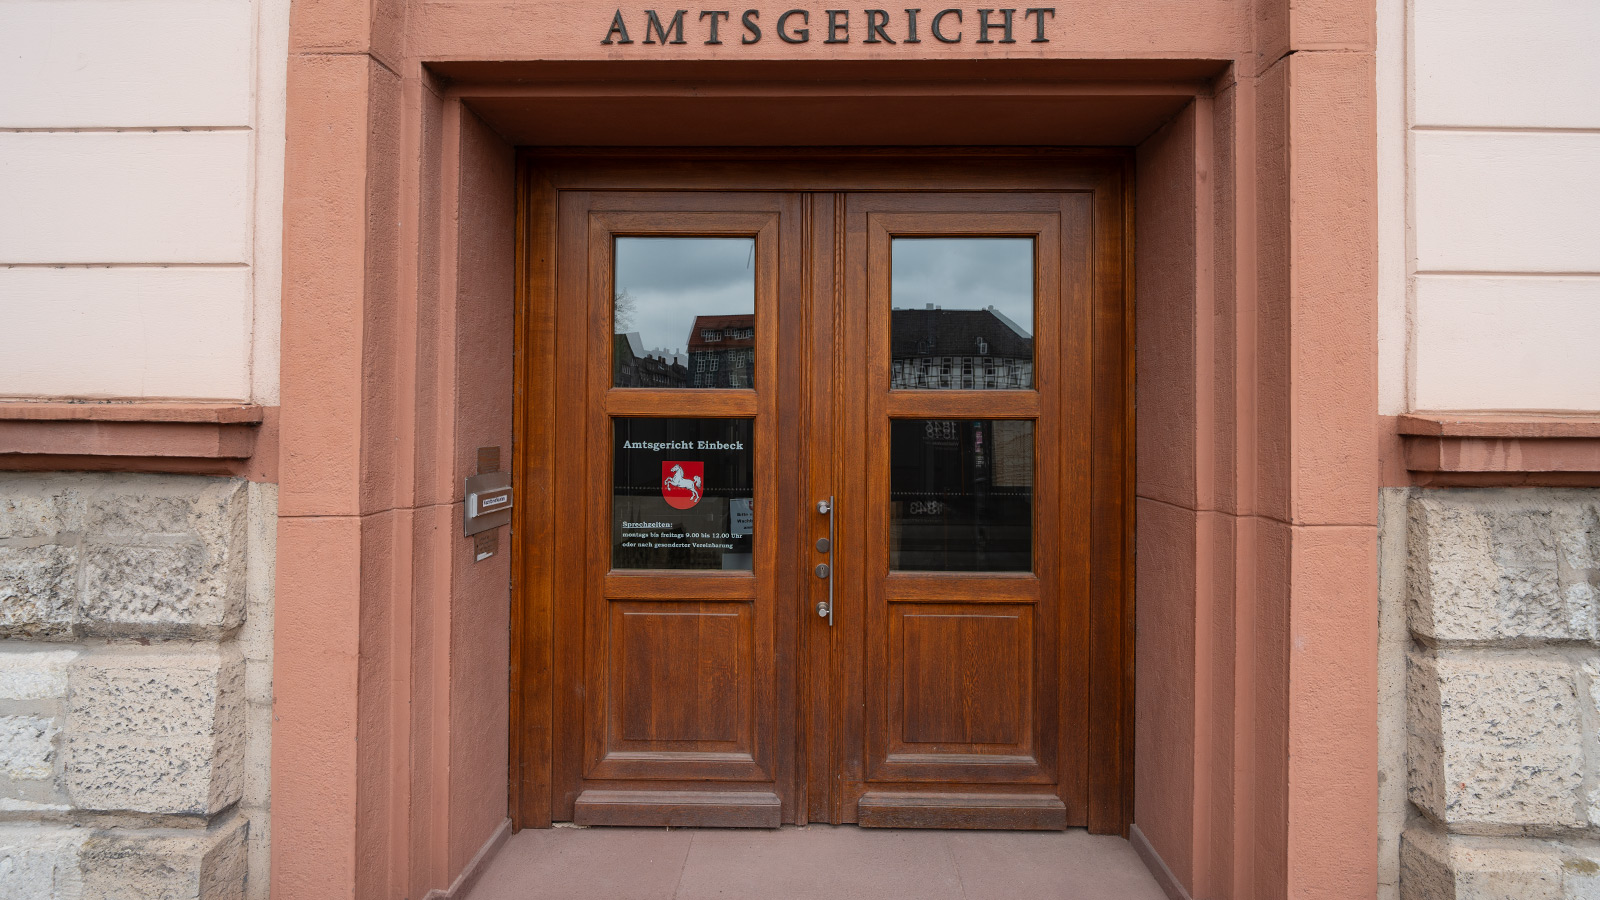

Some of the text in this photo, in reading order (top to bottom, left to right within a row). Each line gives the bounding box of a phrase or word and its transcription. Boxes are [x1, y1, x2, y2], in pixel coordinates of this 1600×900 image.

[600, 8, 1056, 45] AMTSGERICHT
[623, 440, 744, 451] Amtsgericht Einbeck
[622, 520, 673, 529] Sprechzeiten:
[692, 542, 734, 550] Vereinbarung
